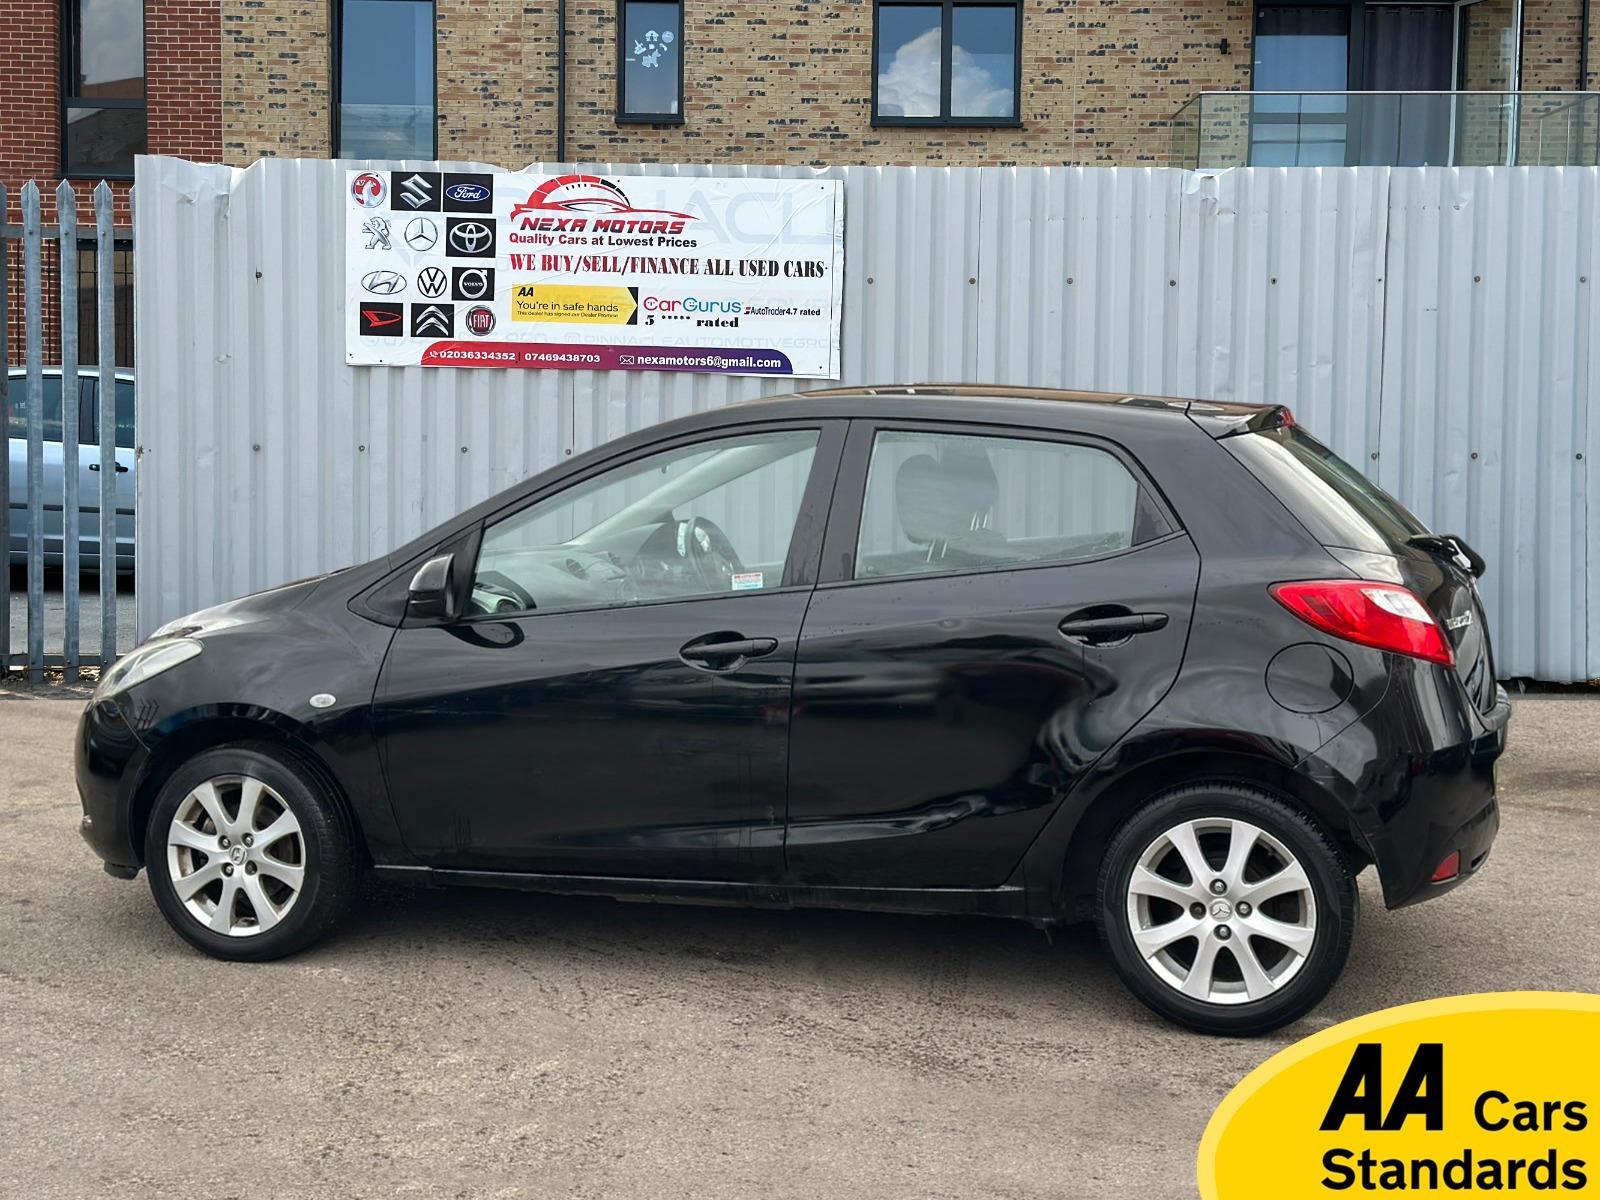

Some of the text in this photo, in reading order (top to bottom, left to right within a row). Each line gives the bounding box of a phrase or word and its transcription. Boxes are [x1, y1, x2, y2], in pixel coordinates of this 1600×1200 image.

[454, 186, 481, 199] Ford
[519, 217, 686, 235] NEXA MOTORS
[509, 233, 697, 248] Quality Cars at Lowest Prices
[509, 253, 536, 271] WE
[704, 258, 733, 276] ALL
[739, 259, 780, 277] USED
[783, 260, 825, 278] CARS
[517, 287, 534, 297] AA
[516, 300, 619, 312] You're in safe hands
[643, 296, 742, 313] CarGurus
[800, 308, 821, 316] rated
[473, 314, 490, 328] FIAT
[645, 315, 739, 328] 5 rated
[439, 351, 601, 363] 02036334352 07469438703
[637, 355, 782, 369] nexamotors6@gmail.com
